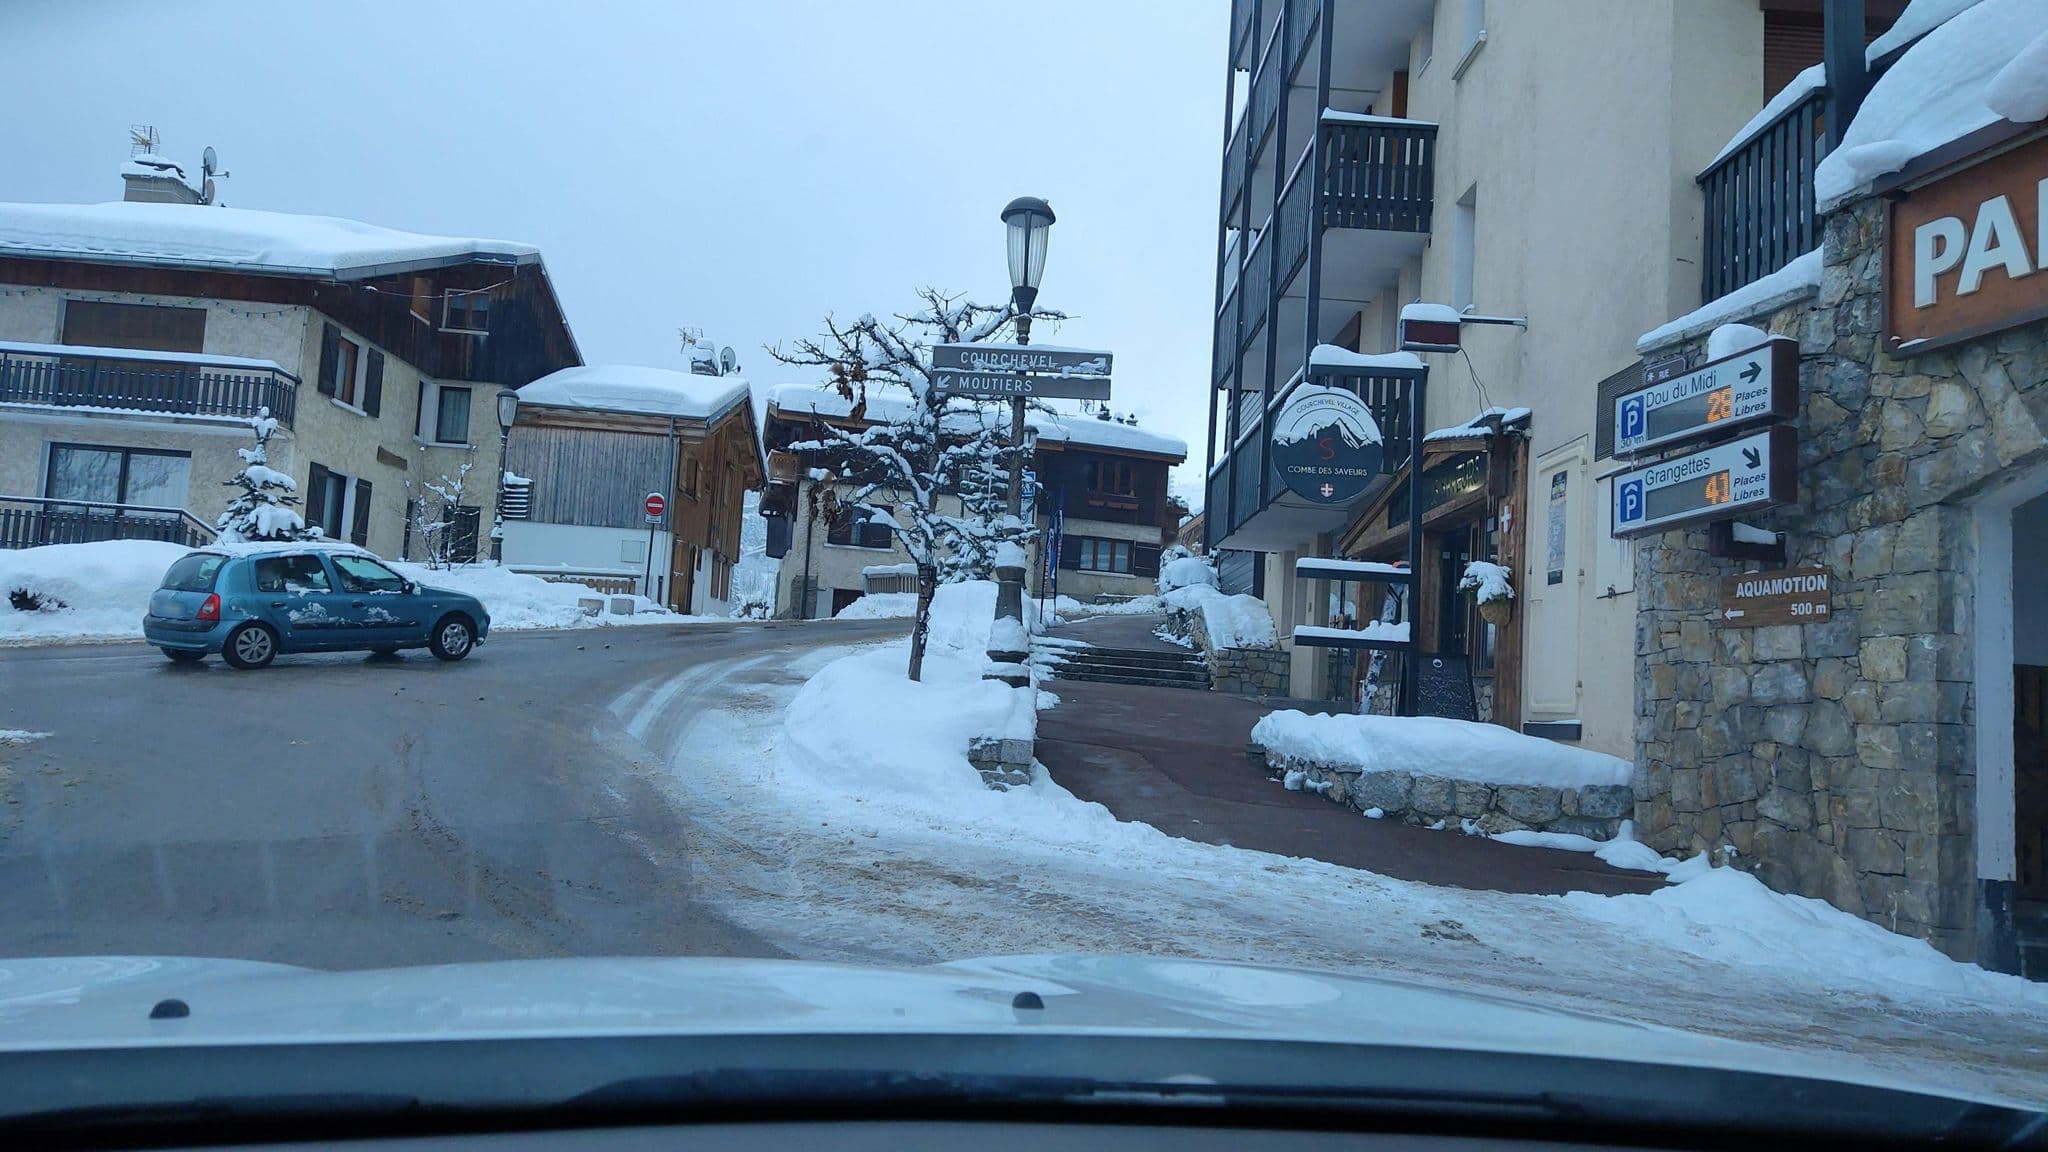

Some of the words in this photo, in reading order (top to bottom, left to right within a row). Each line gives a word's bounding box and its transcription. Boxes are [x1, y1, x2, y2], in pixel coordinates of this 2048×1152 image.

[1914, 176, 2048, 309] PA
[960, 351, 1057, 368] COURCHEVEL
[959, 376, 1033, 392] MOUTIERS
[1646, 391, 1669, 408] Dou
[1673, 384, 1687, 399] du
[1691, 370, 1717, 394] Midi
[1735, 386, 1768, 403] Places
[1296, 399, 1335, 414] COURCHEVEL
[1734, 401, 1766, 417] Libres
[1287, 465, 1317, 474] COMBE
[1318, 466, 1332, 475] DES
[1334, 467, 1368, 477] SAVEURS
[1645, 457, 1711, 486] Grangettes
[1705, 472, 1730, 505] 41
[1733, 473, 1766, 488] Places
[1733, 487, 1764, 502] Libres
[1736, 574, 1828, 598] AQUAMOTION
[1790, 602, 1813, 616] 500
[1815, 603, 1827, 614] m
